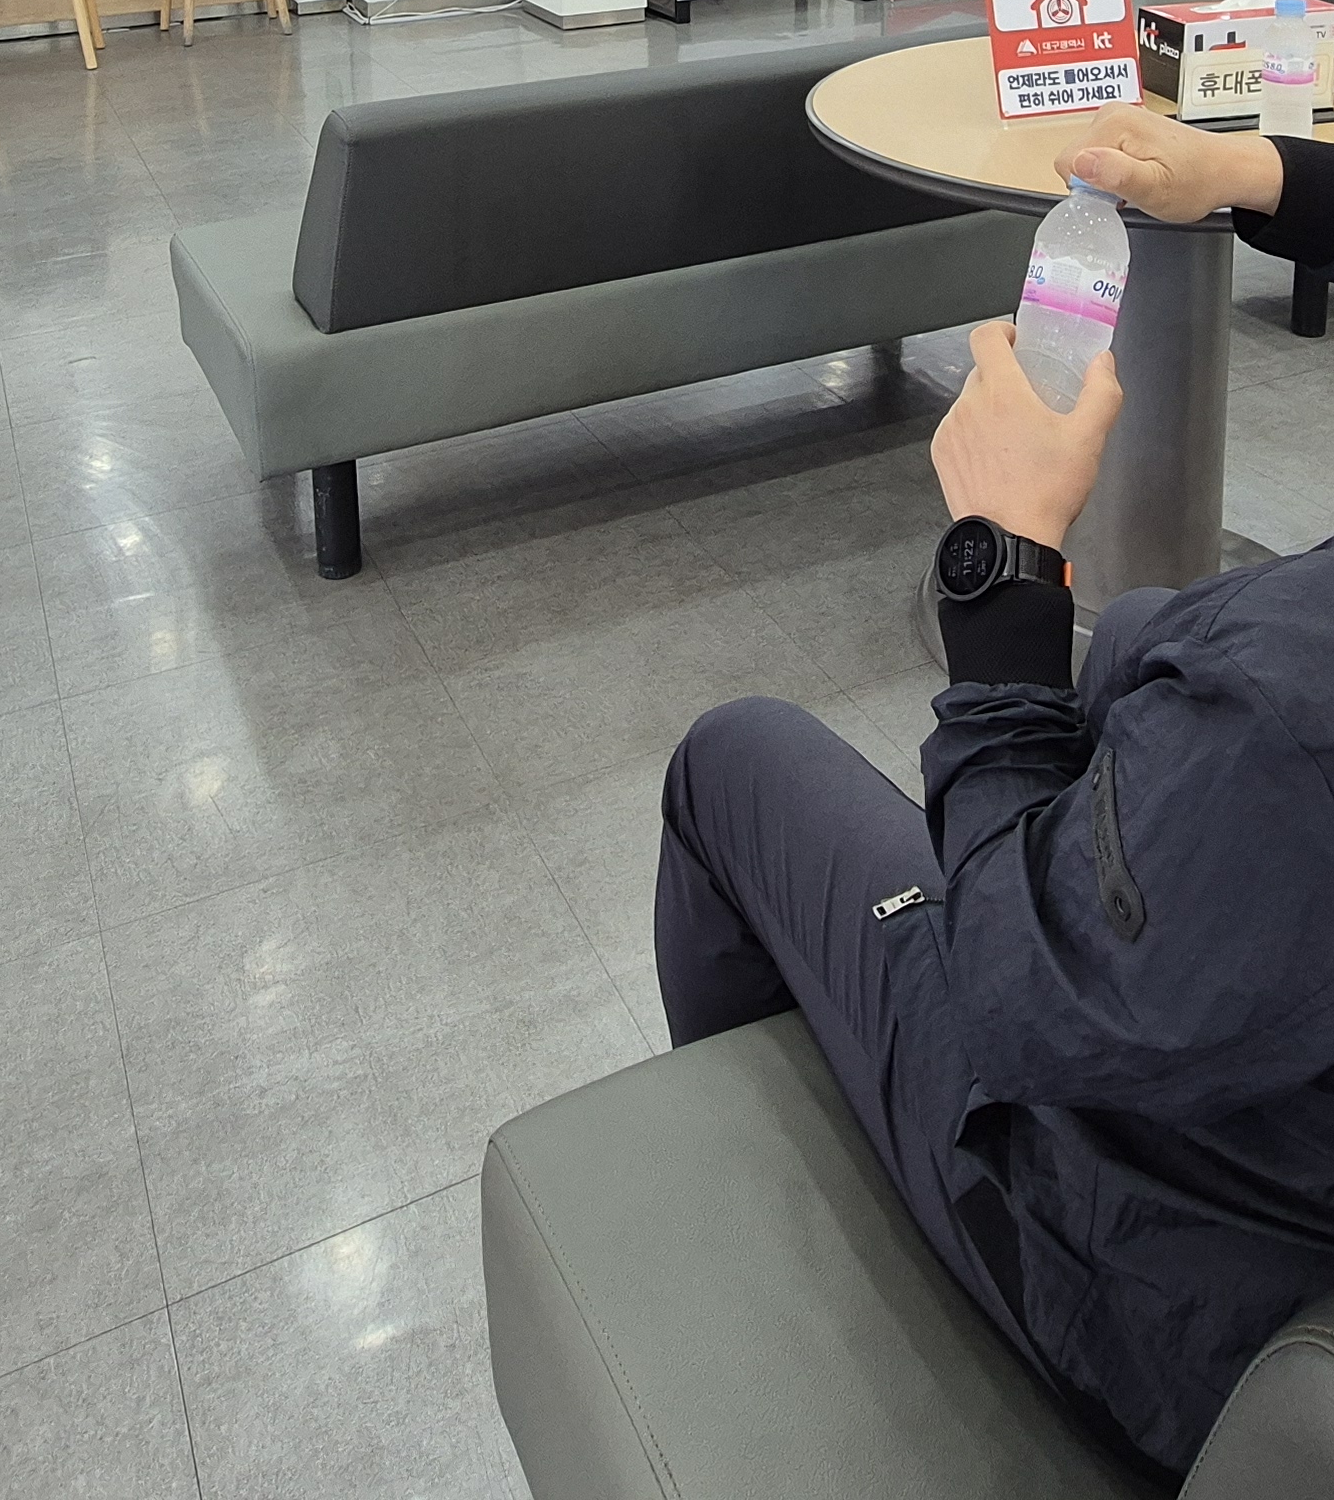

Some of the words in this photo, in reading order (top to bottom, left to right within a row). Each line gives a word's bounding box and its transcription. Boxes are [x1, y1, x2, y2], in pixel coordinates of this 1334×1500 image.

[1092, 31, 1113, 50] kt
[1139, 17, 1160, 52] kt
[1315, 30, 1327, 39] TV
[1158, 40, 1180, 60] plaza
[1007, 70, 1061, 90] 언제라도
[1063, 63, 1129, 85] 들어오셔서
[1018, 92, 1046, 109] 편히
[1047, 88, 1075, 107] 쉬어
[1077, 83, 1122, 102] 가세요!
[963, 539, 975, 576] 11:22
